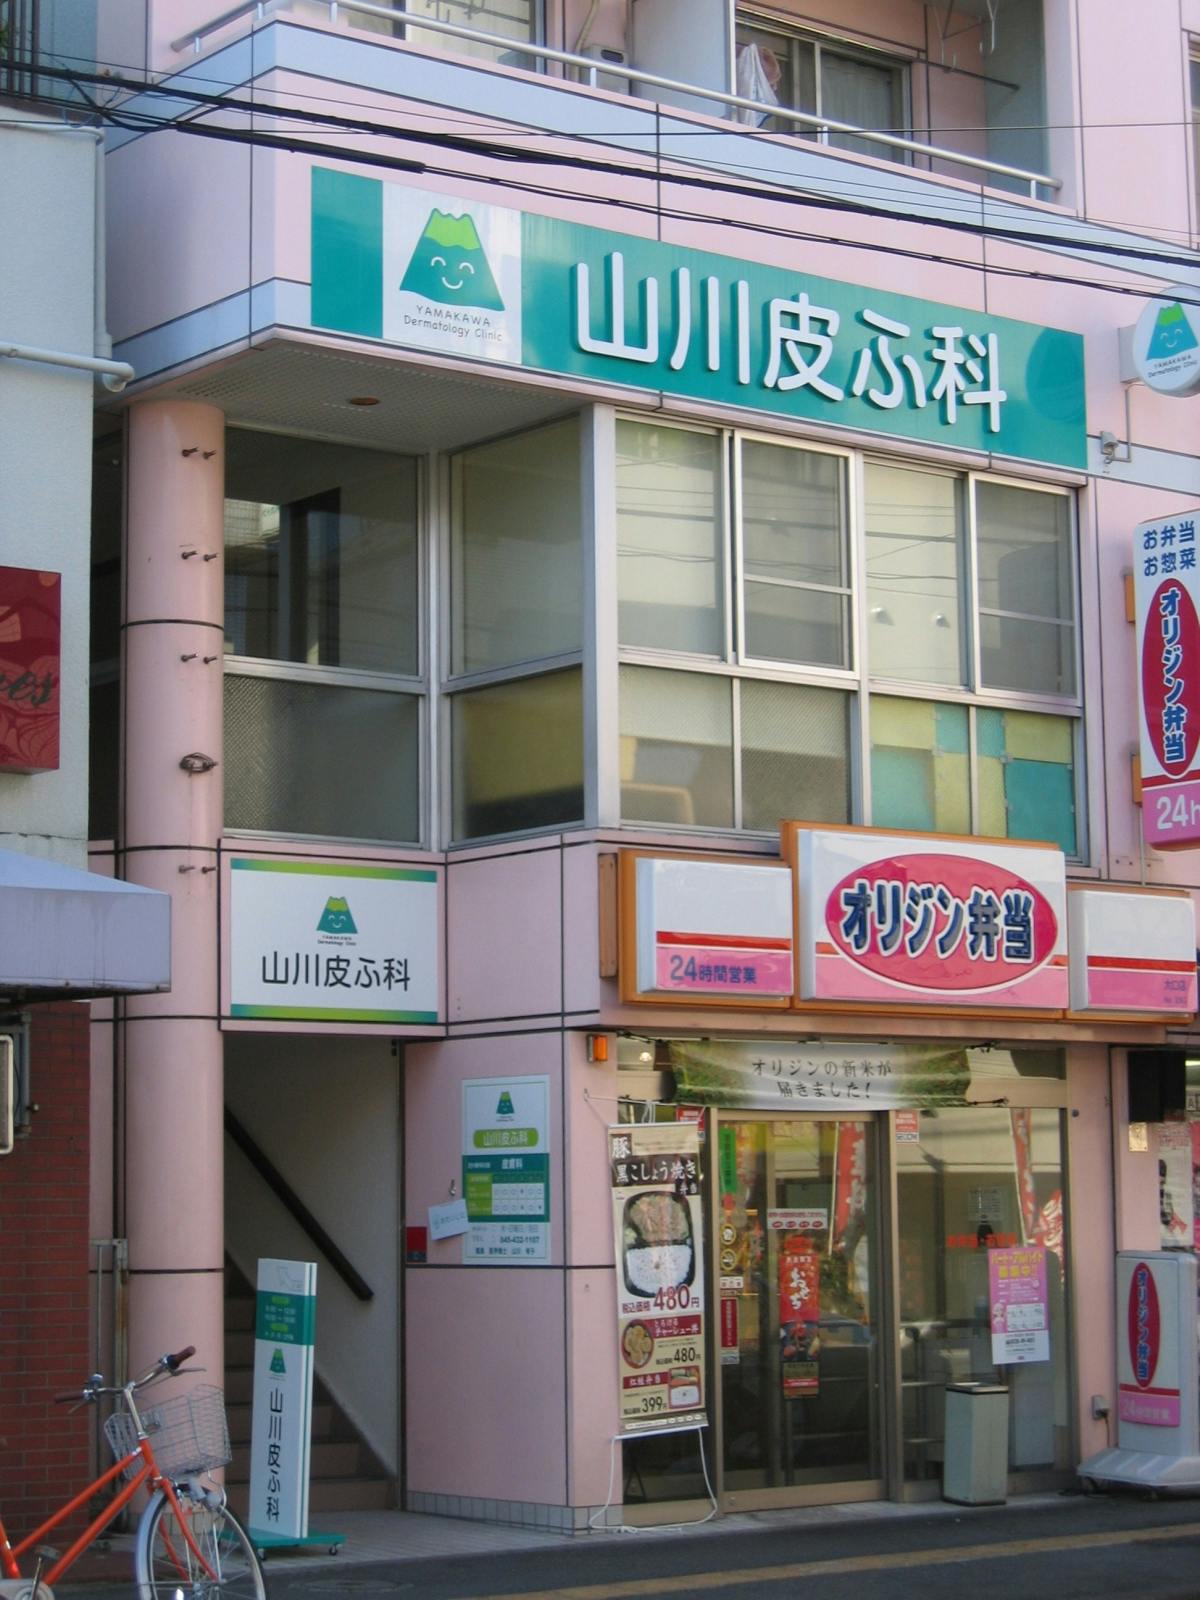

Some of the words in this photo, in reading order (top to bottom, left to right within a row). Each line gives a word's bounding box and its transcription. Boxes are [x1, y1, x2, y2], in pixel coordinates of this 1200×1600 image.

[404, 315, 470, 337] Dermatology
[475, 328, 503, 342] Clinic
[416, 305, 491, 327] YAMAKAWA
[572, 252, 1007, 433] 山川皮ふ科
[1143, 520, 1195, 551] お弁当
[1144, 547, 1196, 577] お惣菜
[1160, 587, 1187, 763] オリジン弁当
[842, 879, 1035, 963] オリジン弁当
[262, 951, 410, 991] 山川皮ふ科
[670, 954, 757, 985] 24時間営業
[751, 1059, 893, 1077] オリジンの新米が
[483, 1129, 529, 1147] 山川皮ふ科
[616, 1159, 697, 1183] 黒こしょう焼き
[266, 1387, 284, 1523] 山川皮ふ科
